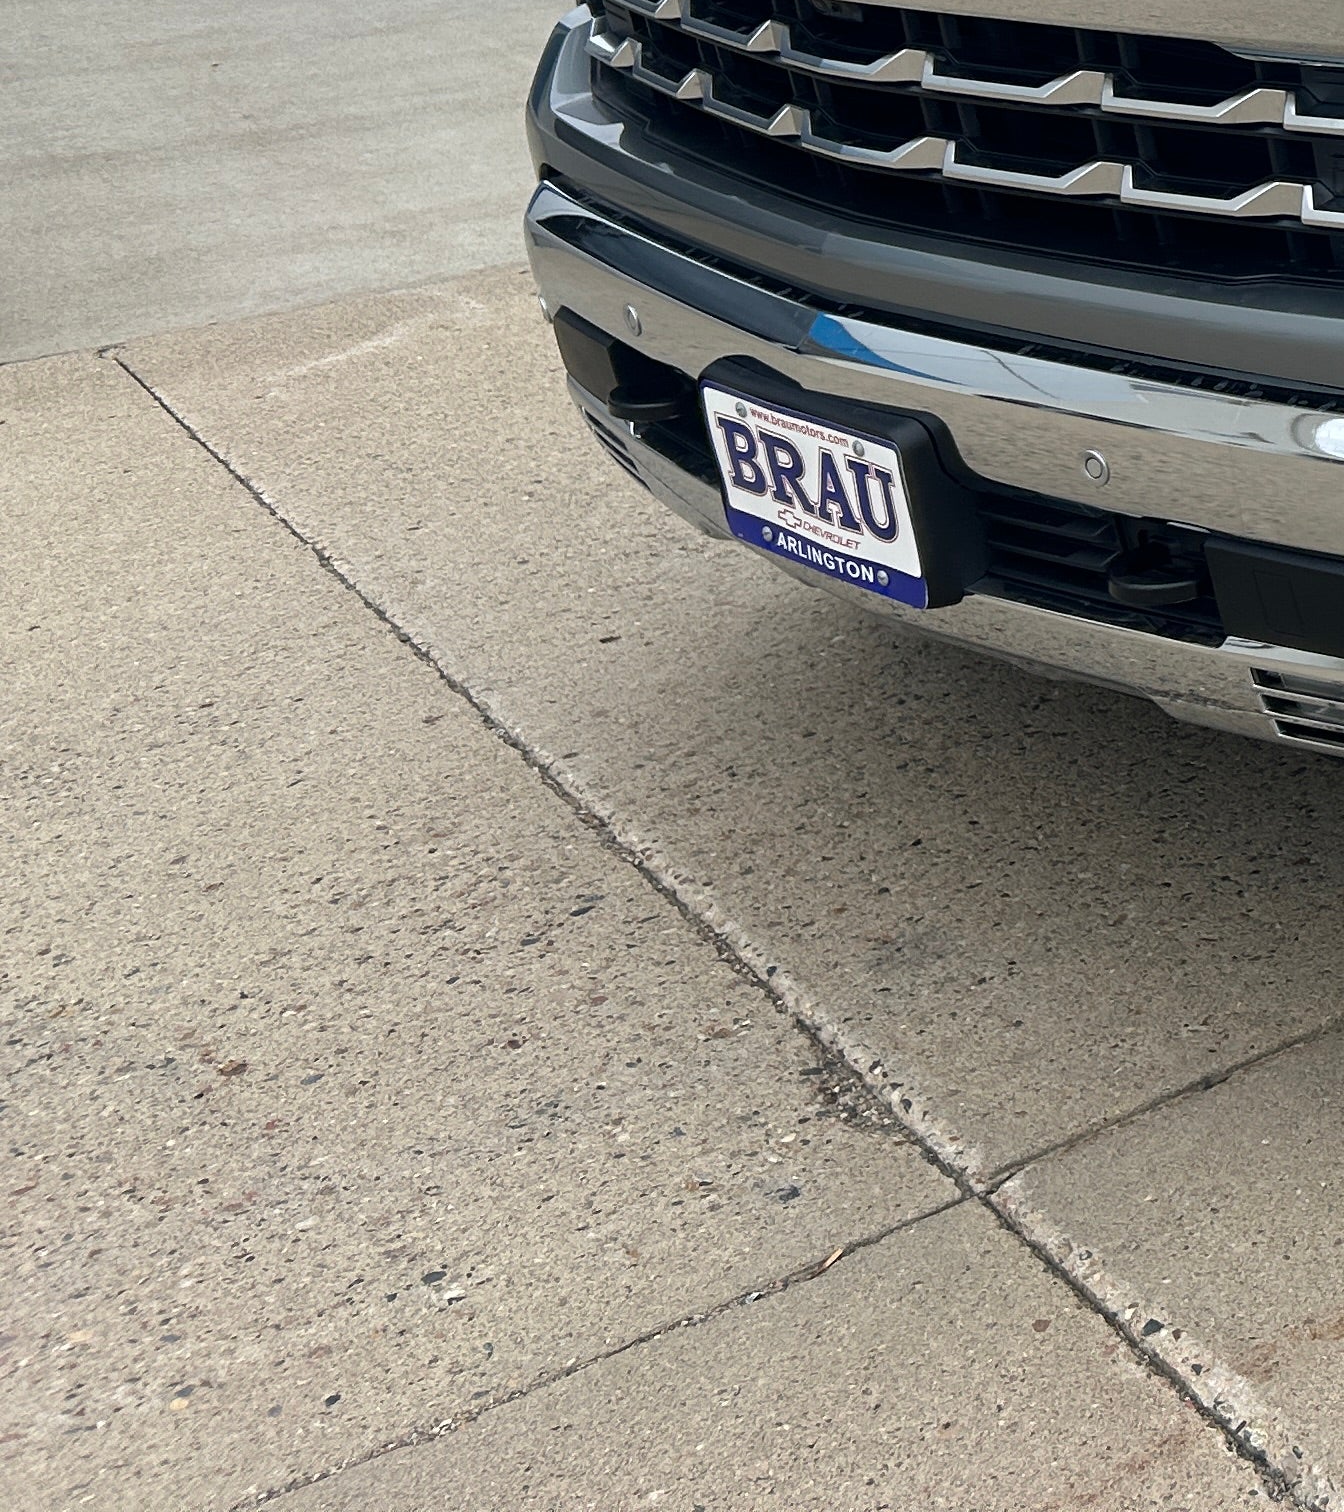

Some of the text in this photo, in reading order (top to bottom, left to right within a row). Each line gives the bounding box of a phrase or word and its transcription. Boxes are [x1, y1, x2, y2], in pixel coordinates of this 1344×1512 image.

[749, 407, 849, 448] www.braumotors.com
[713, 411, 901, 543] BRAU
[776, 531, 875, 583] ARLINGTON
[803, 522, 861, 550] CHEVROLET
